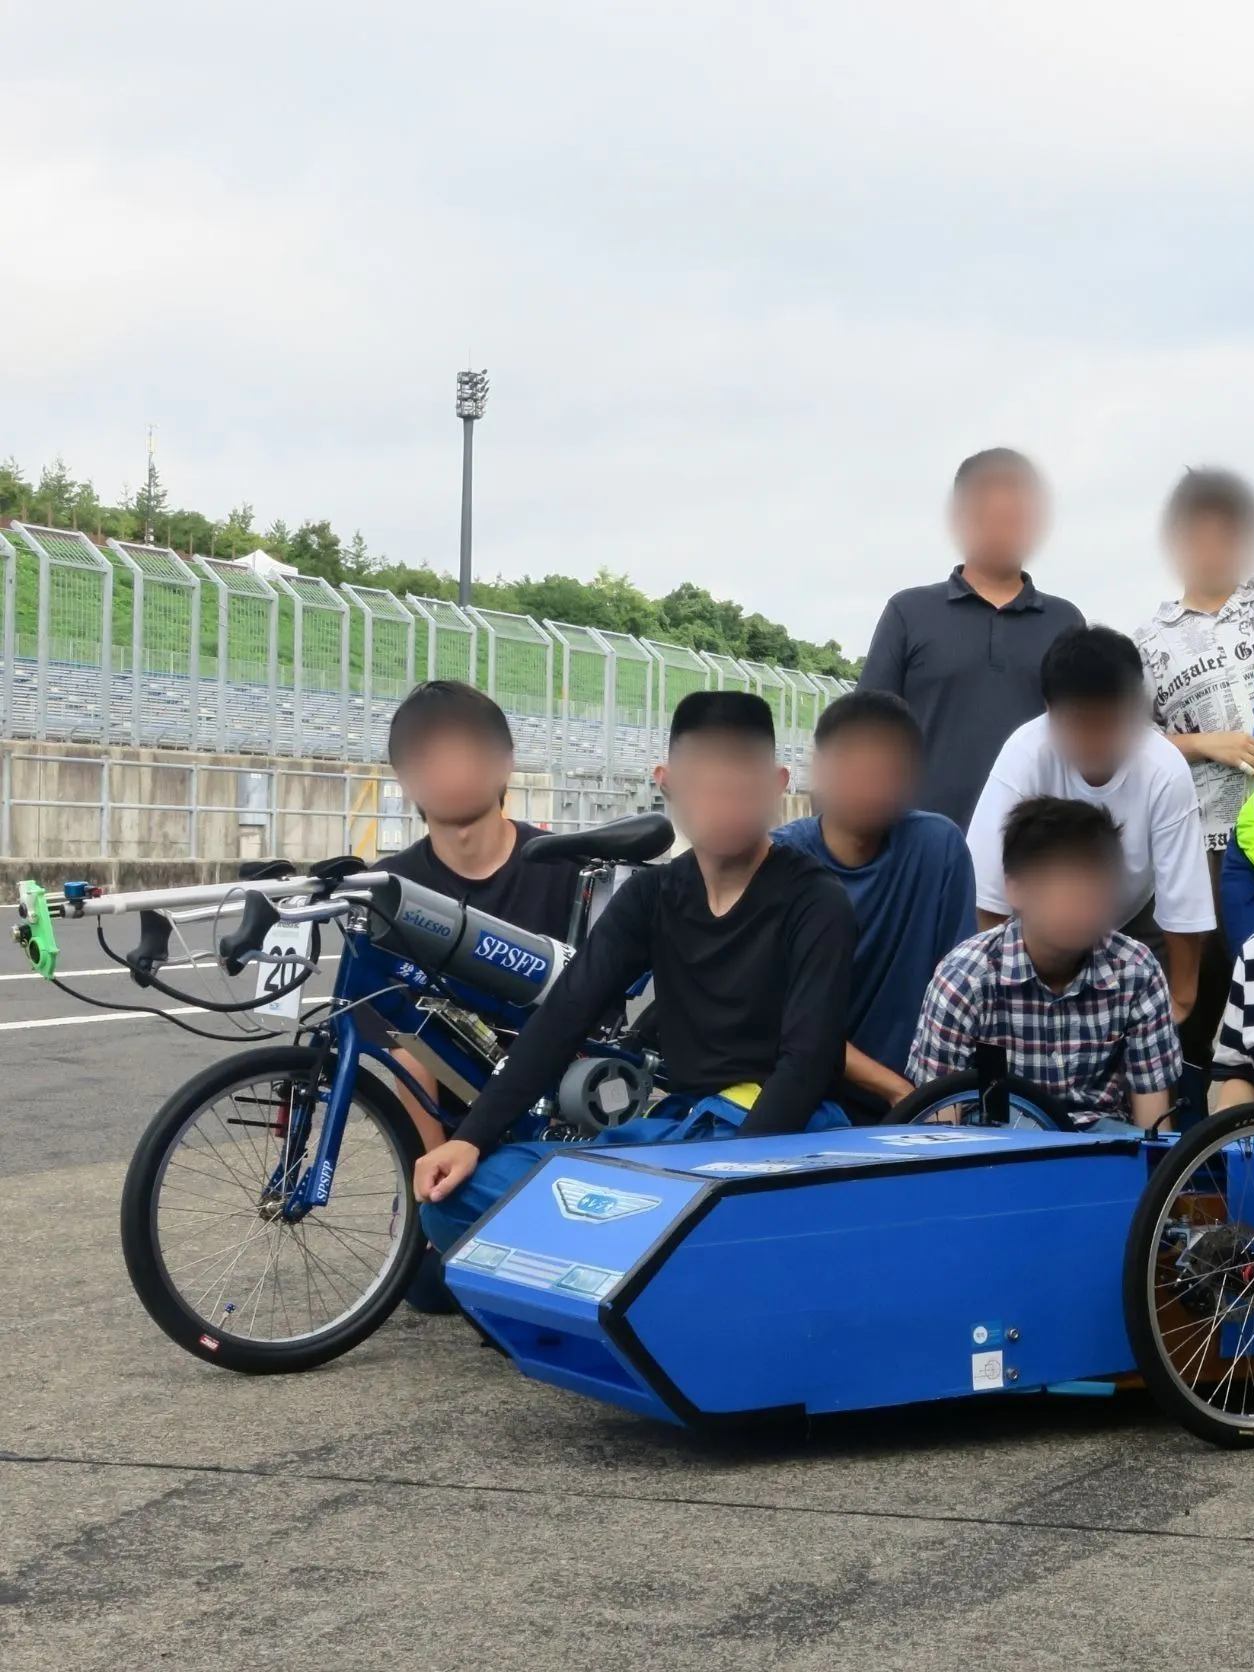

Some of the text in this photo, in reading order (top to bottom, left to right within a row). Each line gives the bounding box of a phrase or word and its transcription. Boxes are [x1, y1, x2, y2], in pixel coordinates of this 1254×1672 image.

[402, 910, 451, 938] SALESIO
[264, 945, 297, 992] 20
[474, 936, 547, 978] SPSFP
[316, 1160, 333, 1202] SPSFP
